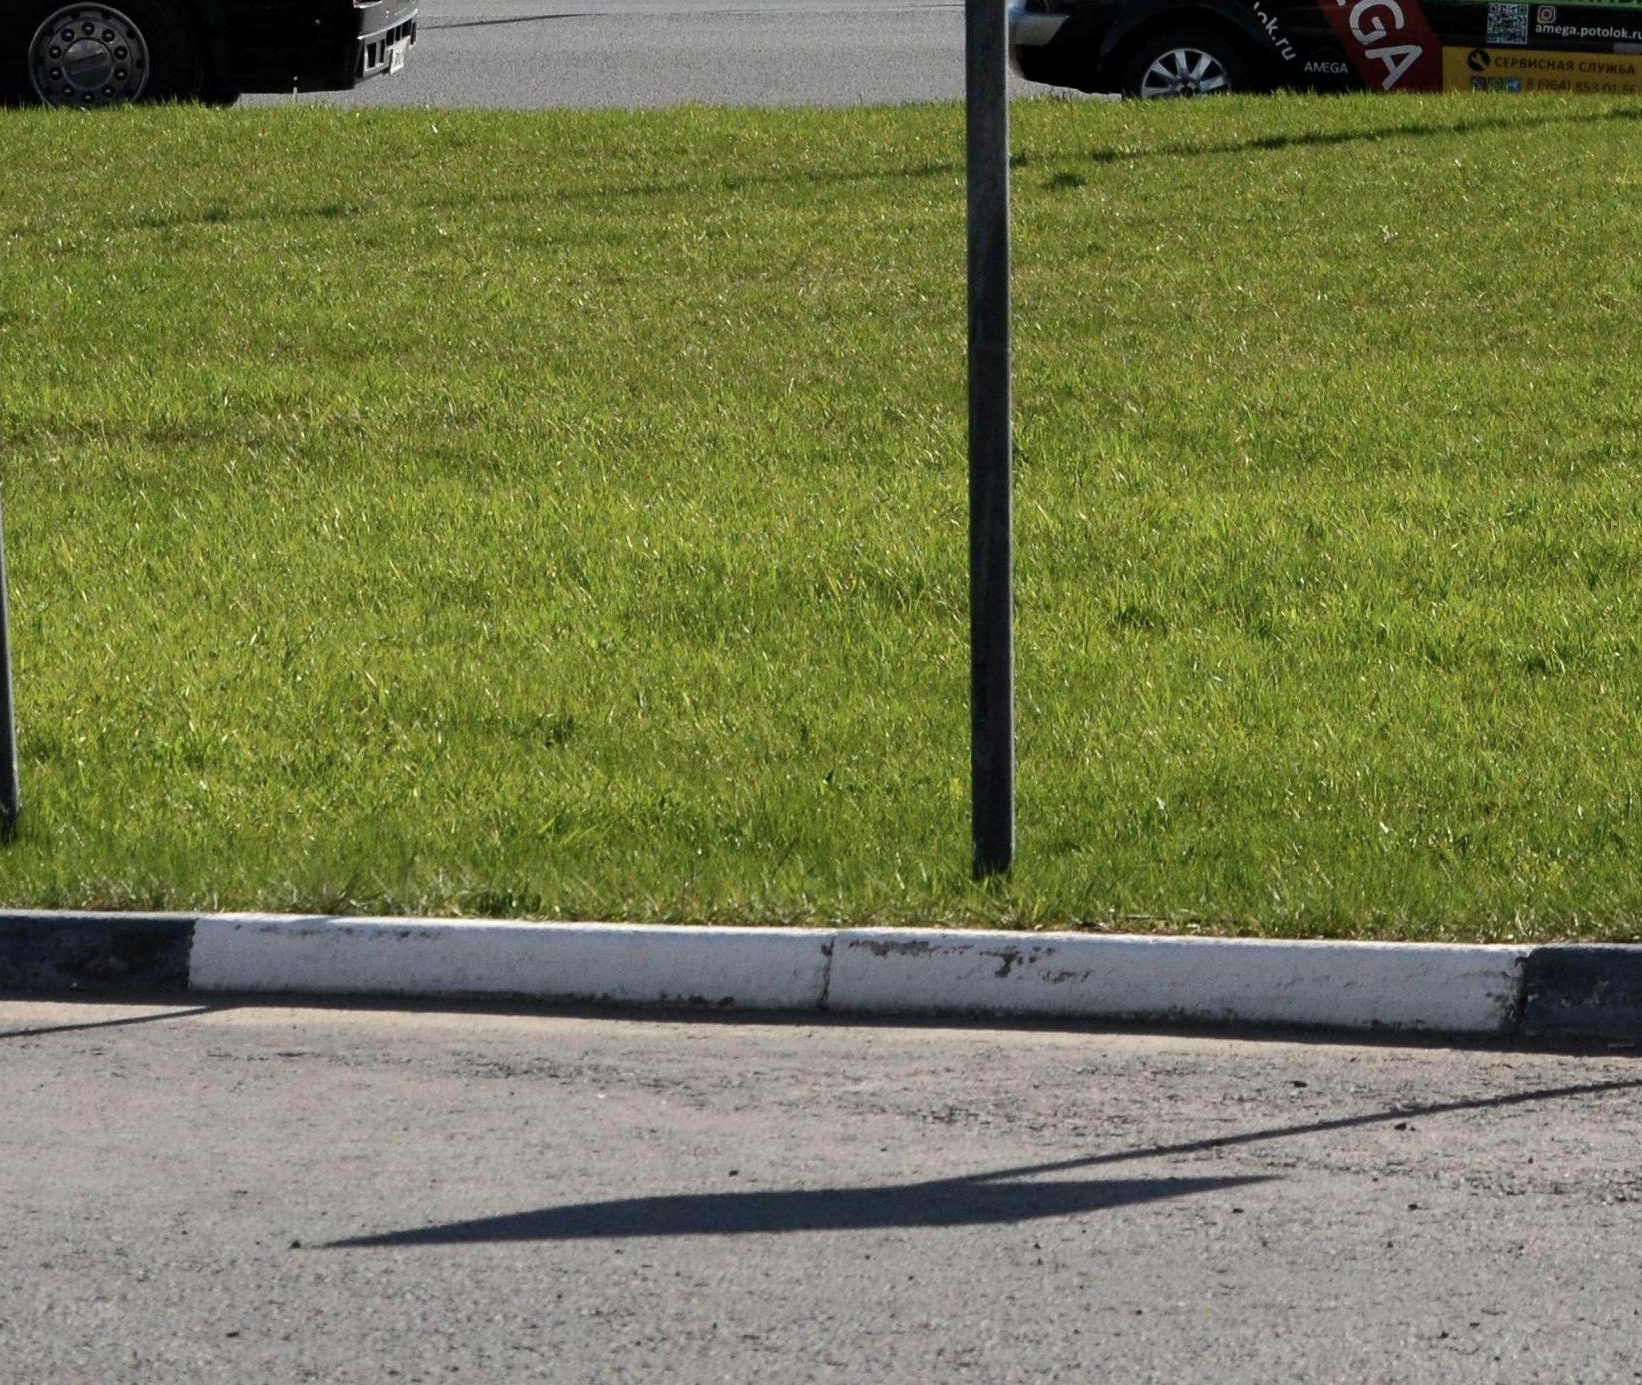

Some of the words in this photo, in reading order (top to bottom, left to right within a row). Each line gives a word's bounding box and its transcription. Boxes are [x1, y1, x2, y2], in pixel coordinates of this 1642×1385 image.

[1304, 61, 1348, 74] AMEGA
[1494, 55, 1574, 72] СЕРВИСНАЯ
[1578, 60, 1636, 75] СЛУЖБА
